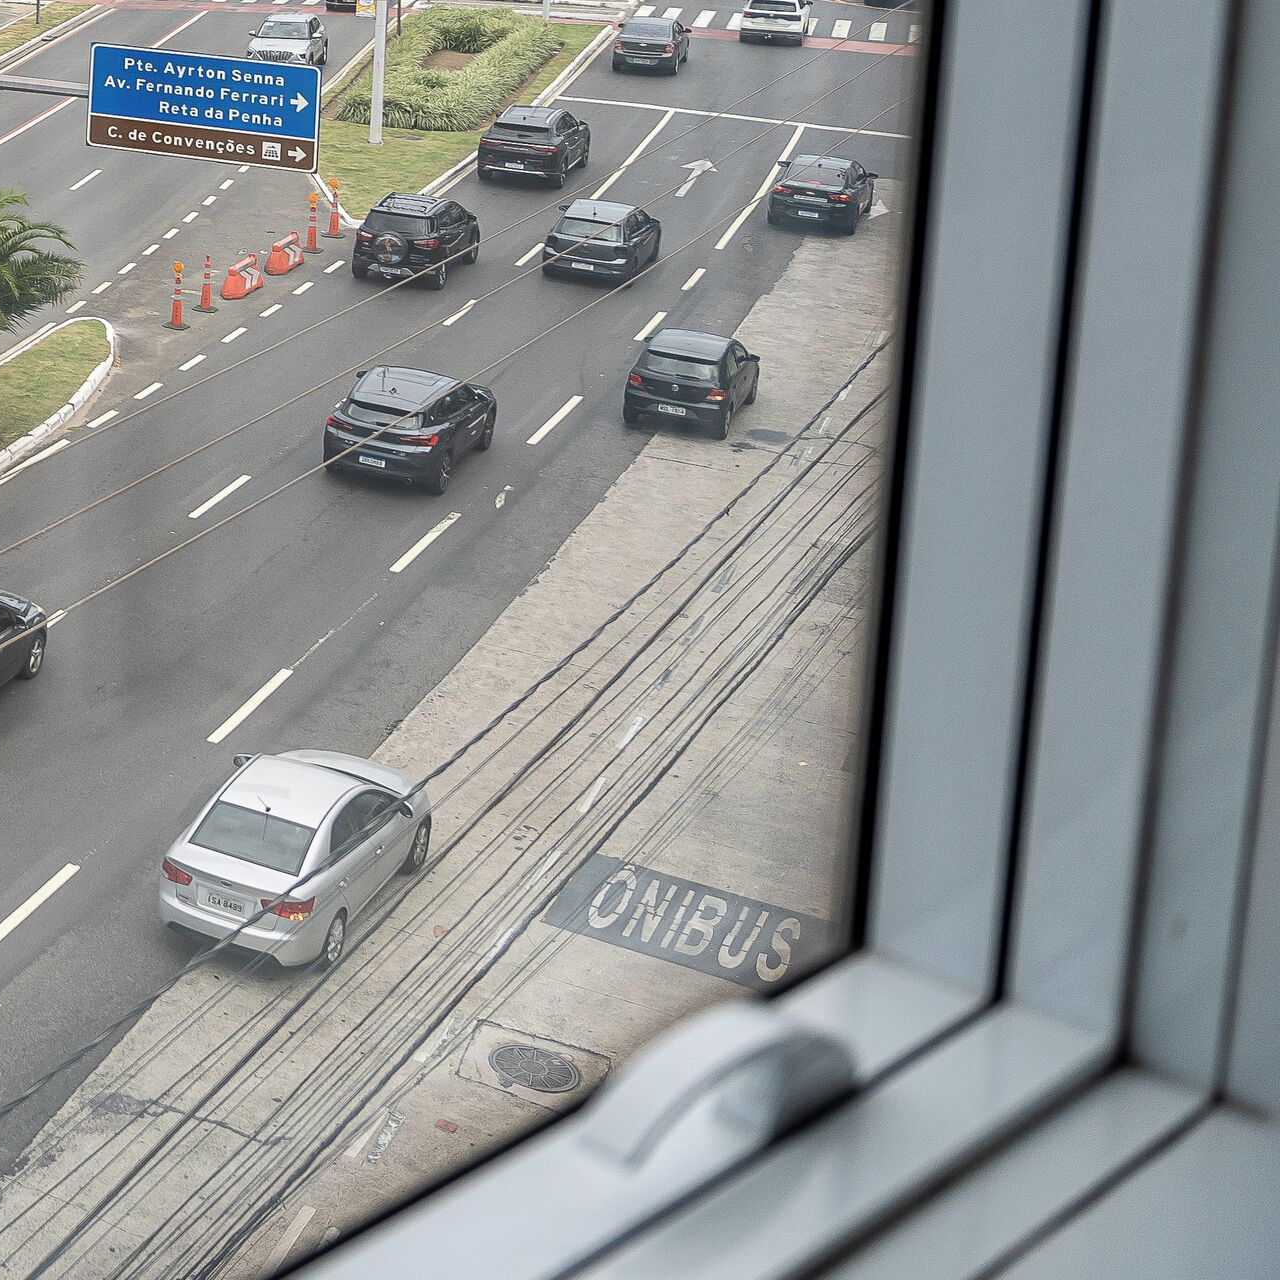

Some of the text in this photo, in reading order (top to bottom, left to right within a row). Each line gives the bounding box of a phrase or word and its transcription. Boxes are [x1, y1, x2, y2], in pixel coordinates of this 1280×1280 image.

[124, 57, 285, 86] Pte. Ayrton Senna
[104, 75, 284, 107] Av. Fernando Ferrari
[159, 101, 283, 127] Reta da Penha
[107, 126, 255, 156] C. de Convenções
[588, 864, 801, 983] ÔNIBUS
